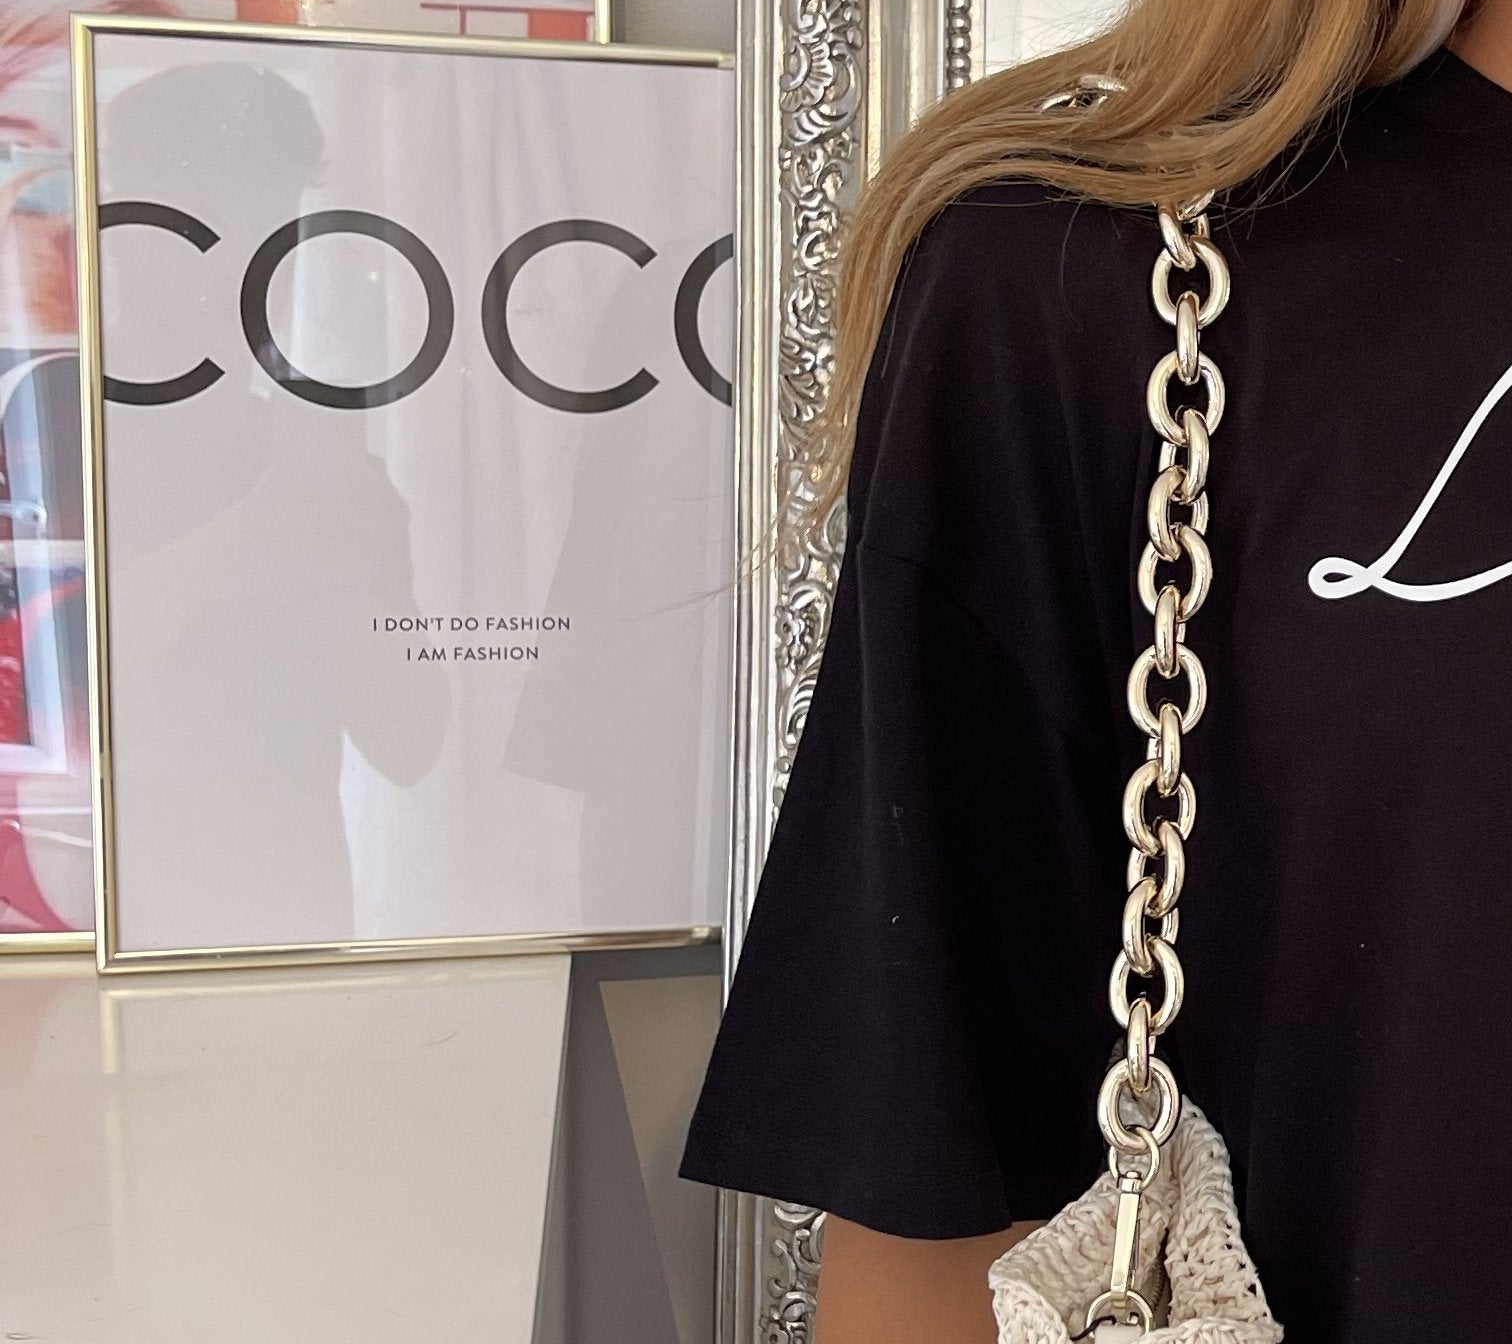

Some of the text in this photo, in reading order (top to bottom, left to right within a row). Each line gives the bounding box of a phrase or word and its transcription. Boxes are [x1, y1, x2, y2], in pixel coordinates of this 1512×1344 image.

[98, 201, 733, 414] COC
[373, 616, 571, 632] I DON'T DO FASHION
[407, 646, 539, 661] I AM FASHION
